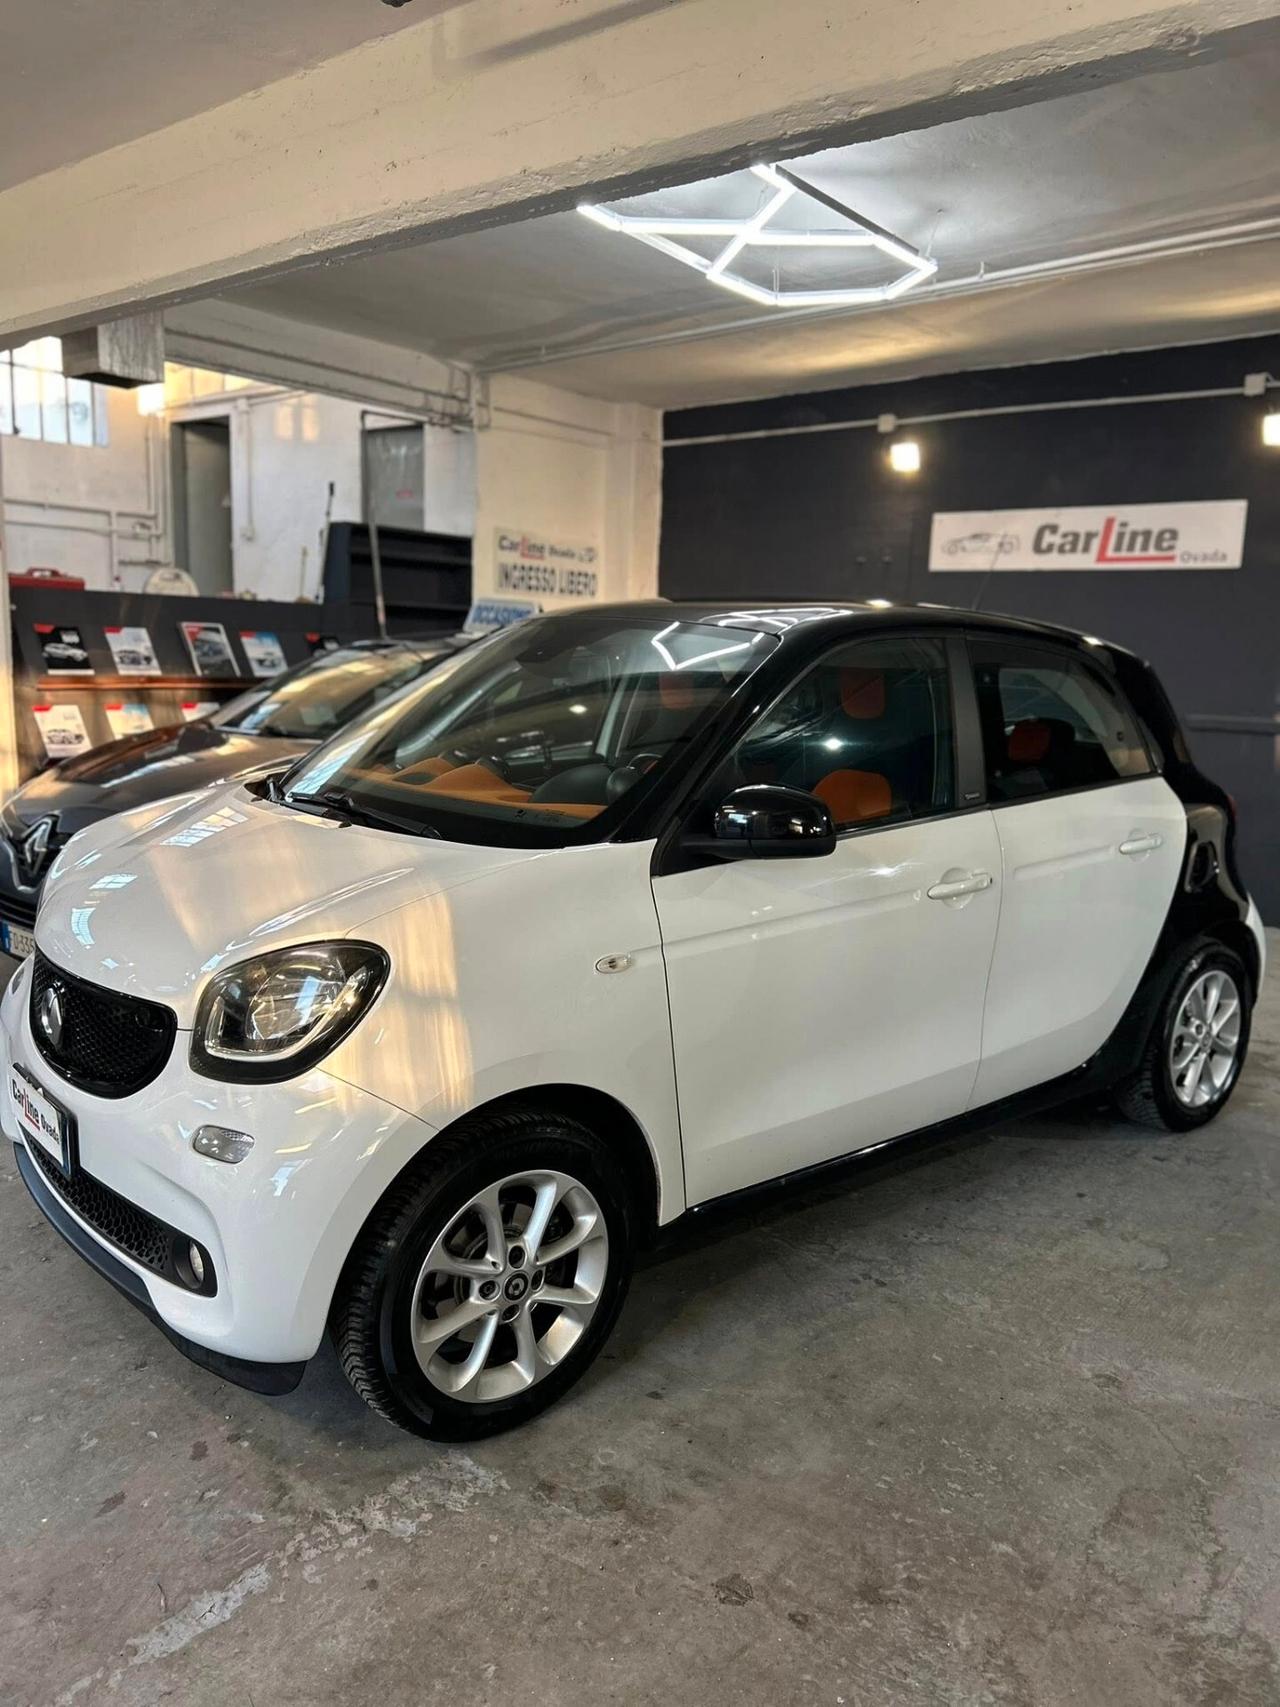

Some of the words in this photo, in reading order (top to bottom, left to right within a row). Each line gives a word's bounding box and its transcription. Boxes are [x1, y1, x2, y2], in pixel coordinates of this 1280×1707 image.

[1032, 516, 1179, 563] CarLine
[1180, 548, 1228, 565] Ovada
[499, 562, 556, 593] INGRESSO
[559, 568, 597, 598] LIBERO
[12, 1078, 41, 1131] CarLine
[40, 1113, 60, 1145] Ovada
